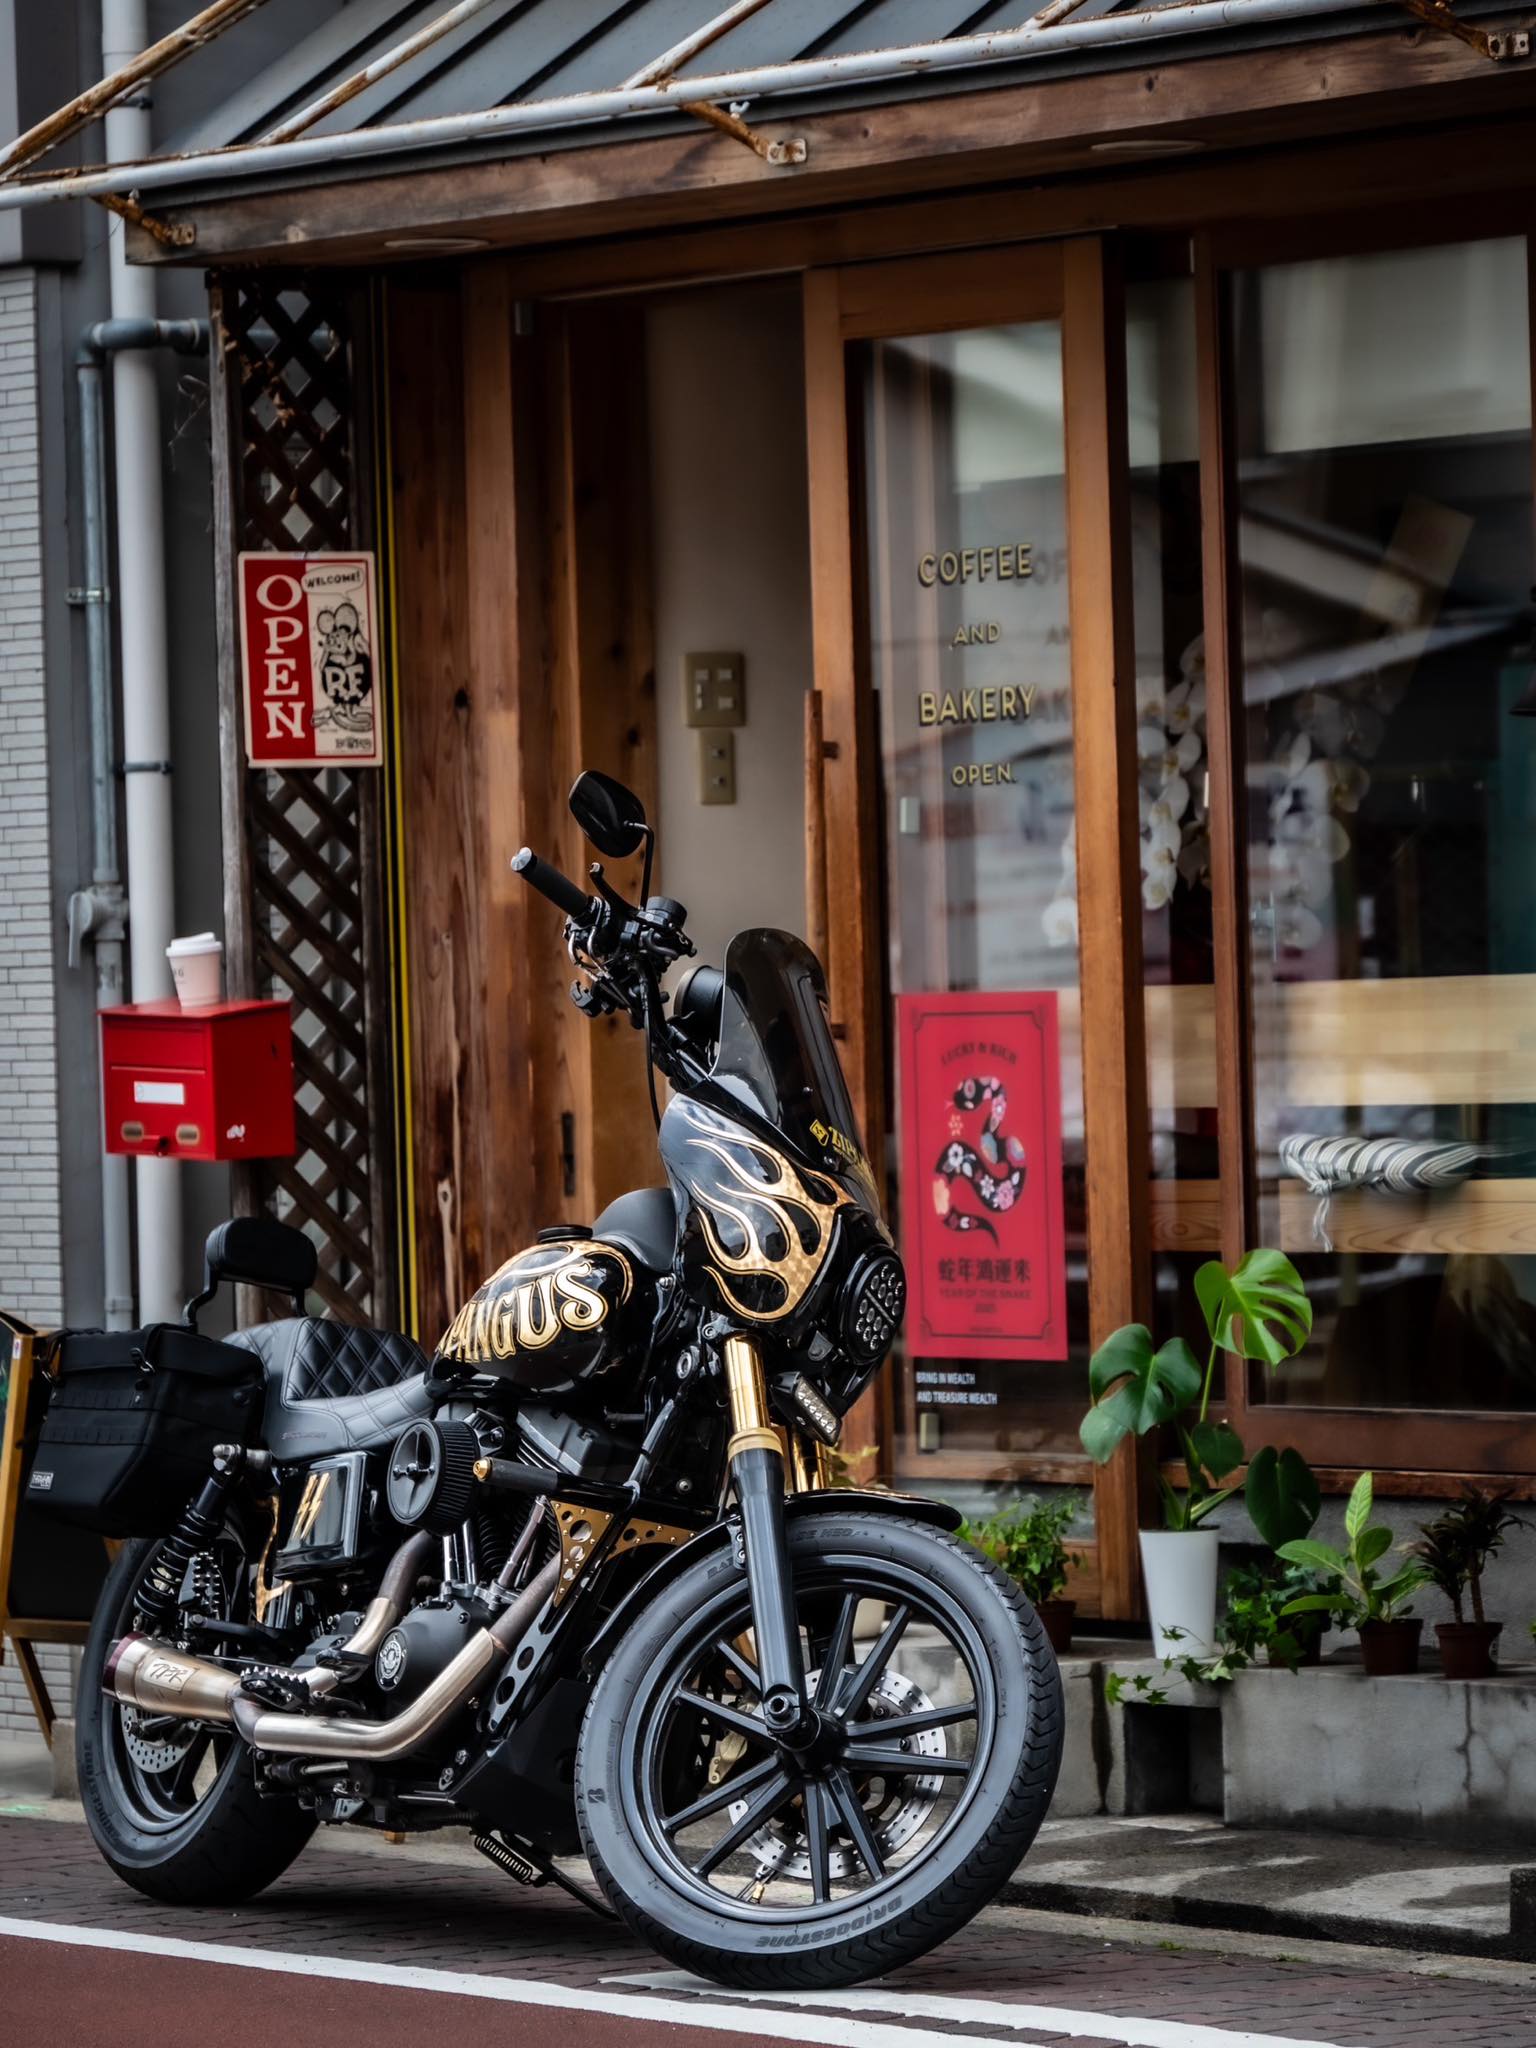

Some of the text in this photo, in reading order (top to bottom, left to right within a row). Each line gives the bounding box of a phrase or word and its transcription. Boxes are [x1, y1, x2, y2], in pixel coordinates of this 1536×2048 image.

[305, 570, 360, 588] WELCOME!
[918, 544, 1033, 587] COFFEE
[953, 622, 1001, 647] AND
[256, 574, 305, 739] OPEN
[918, 684, 1036, 727] BAKERY
[947, 1373, 976, 1385] WEALTH
[917, 1391, 932, 1403] AND
[968, 1393, 998, 1405] WEALTH
[755, 1896, 902, 1947] BRIDGESTONE
